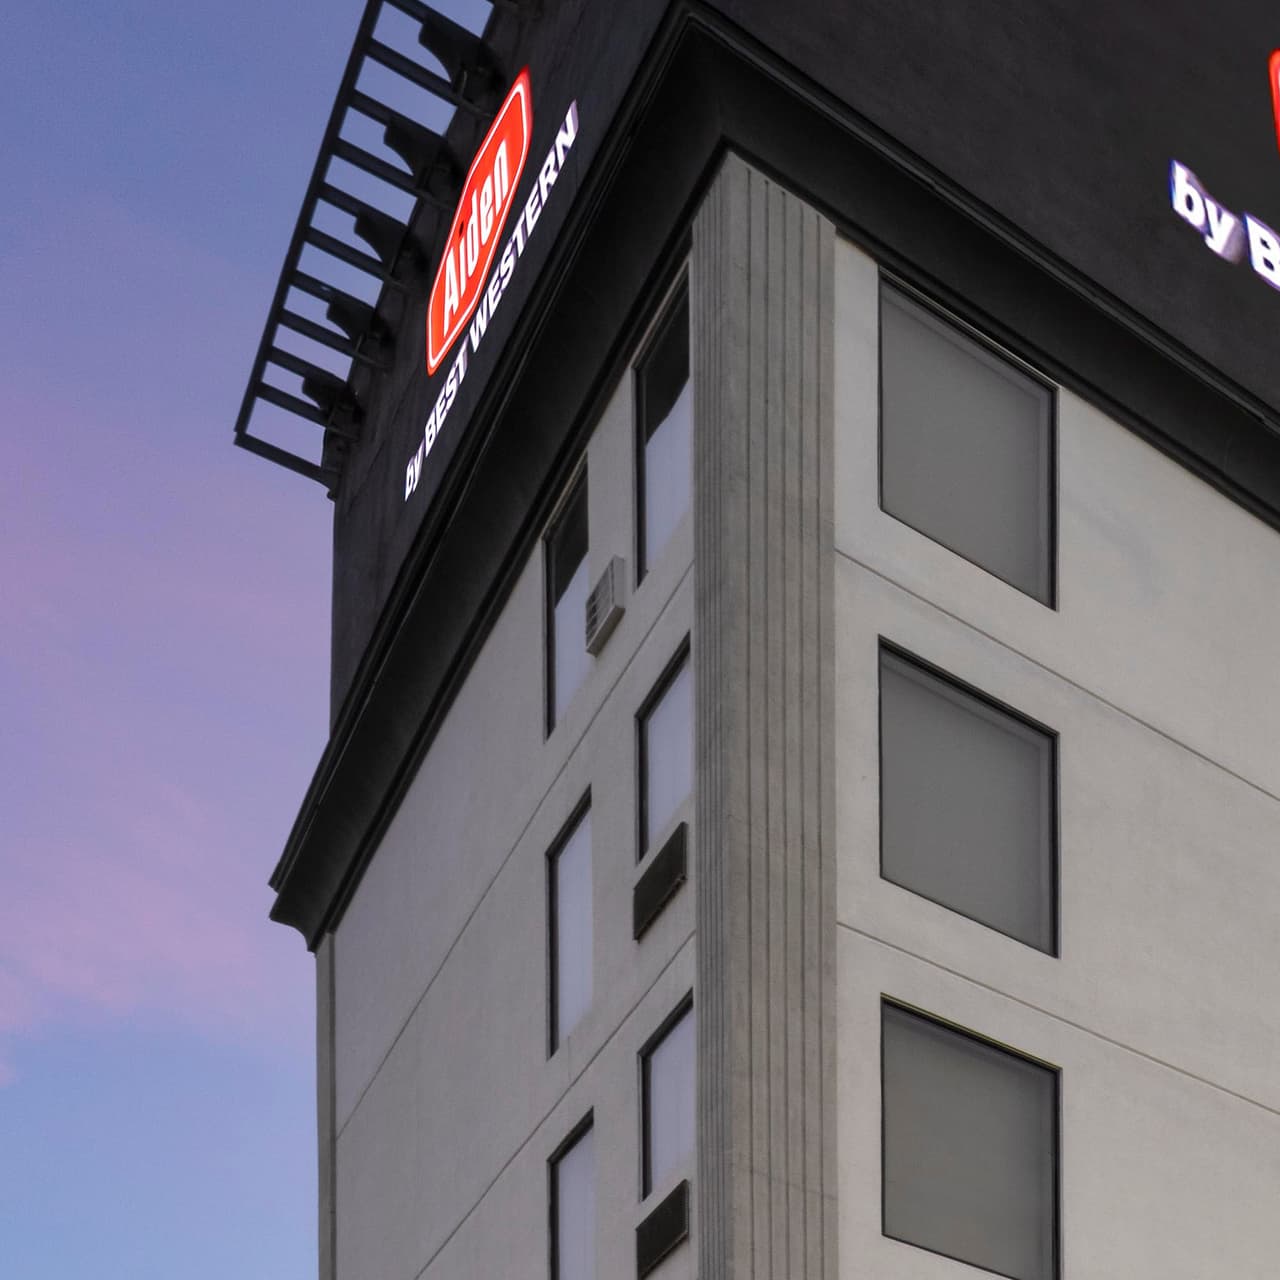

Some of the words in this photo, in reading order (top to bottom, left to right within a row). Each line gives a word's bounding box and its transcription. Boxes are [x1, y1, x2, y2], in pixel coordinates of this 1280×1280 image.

[404, 440, 424, 502] by
[424, 335, 469, 458] BEST
[469, 99, 579, 353] WESTERN
[443, 138, 510, 338] Aiden
[1170, 160, 1243, 263] by
